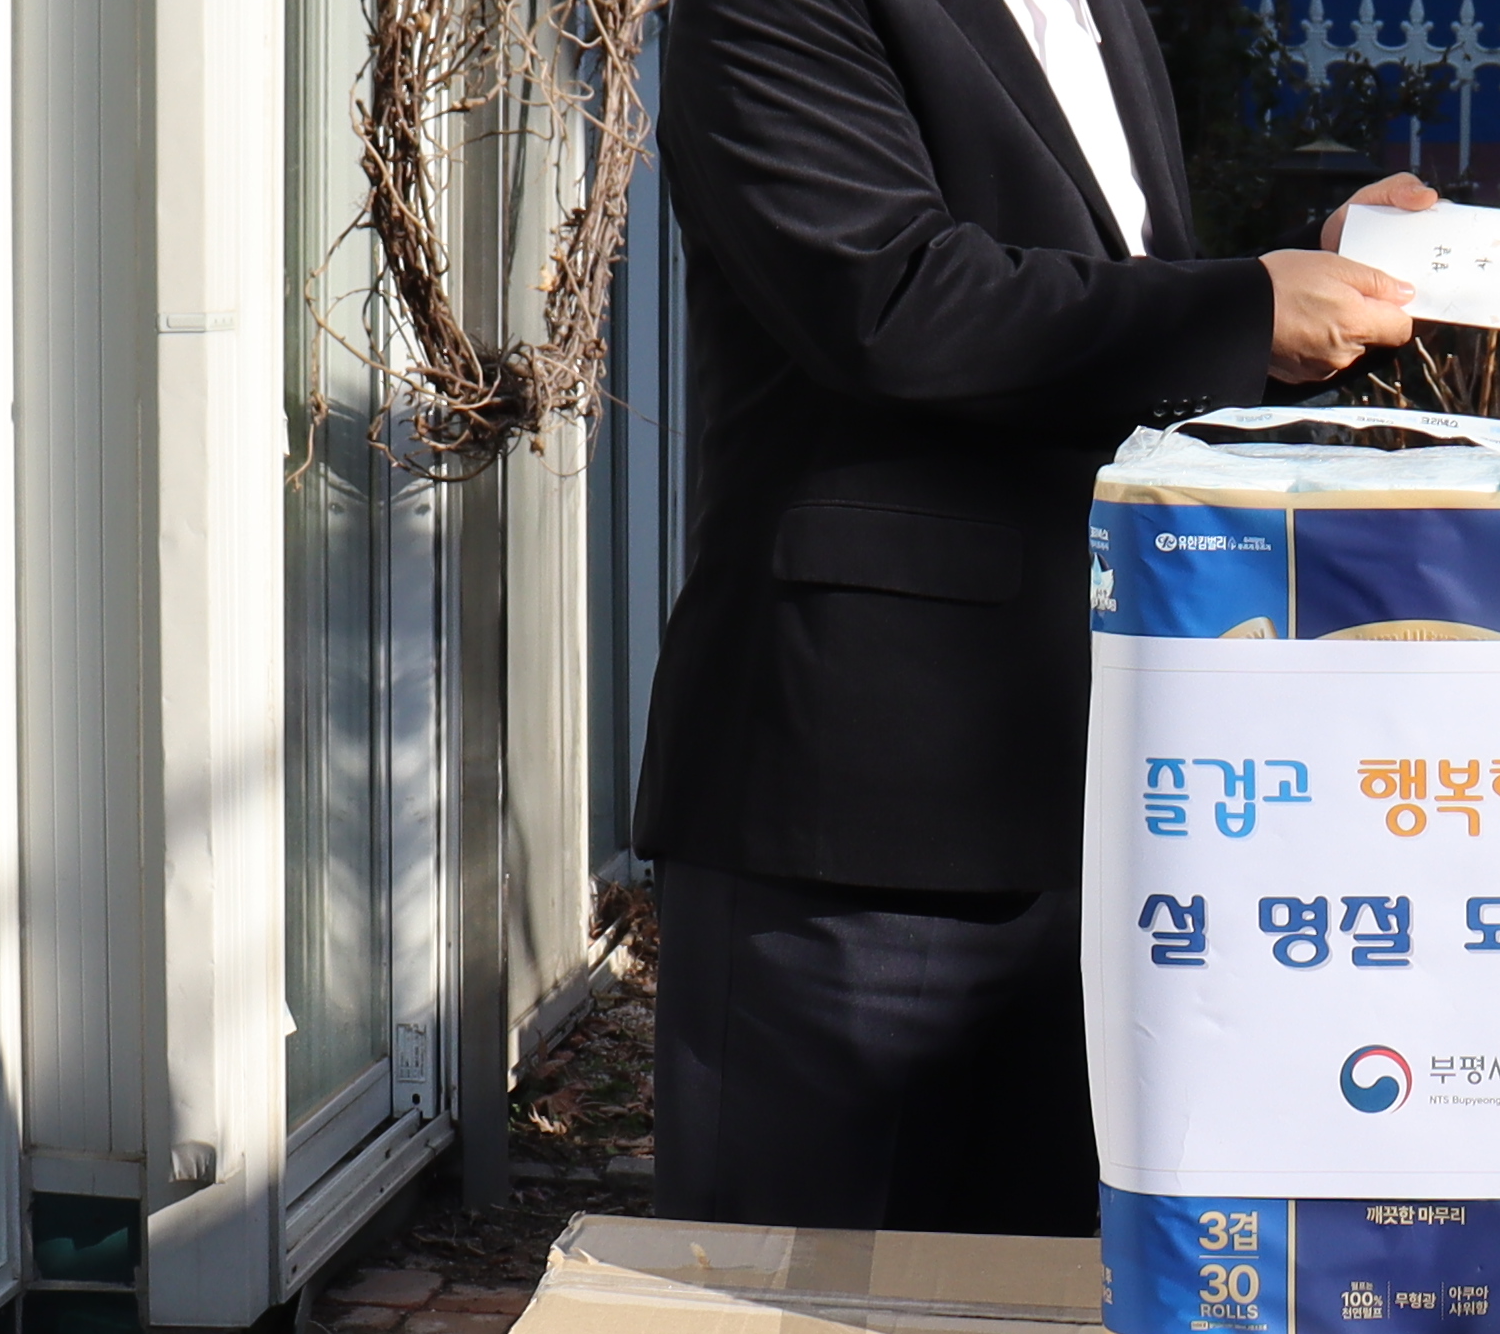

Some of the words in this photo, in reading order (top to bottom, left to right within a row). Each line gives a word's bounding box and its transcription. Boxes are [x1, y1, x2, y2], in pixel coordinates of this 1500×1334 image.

[1178, 535, 1227, 551] 유한킴벌리
[1144, 757, 1311, 838] 즐겁고
[1139, 894, 1207, 966] 설
[1258, 894, 1412, 968] 명절
[1429, 1095, 1449, 1105] NTS
[1365, 1206, 1415, 1227] 깨끗한
[1417, 1205, 1466, 1226] 마무리
[1199, 1210, 1260, 1252] 3겹
[1199, 1264, 1260, 1306] 30
[1449, 1285, 1490, 1302] 아쿠아
[1342, 1291, 1384, 1308] 100%
[1395, 1292, 1437, 1309] 무형광
[1200, 1304, 1259, 1320] ROLLS
